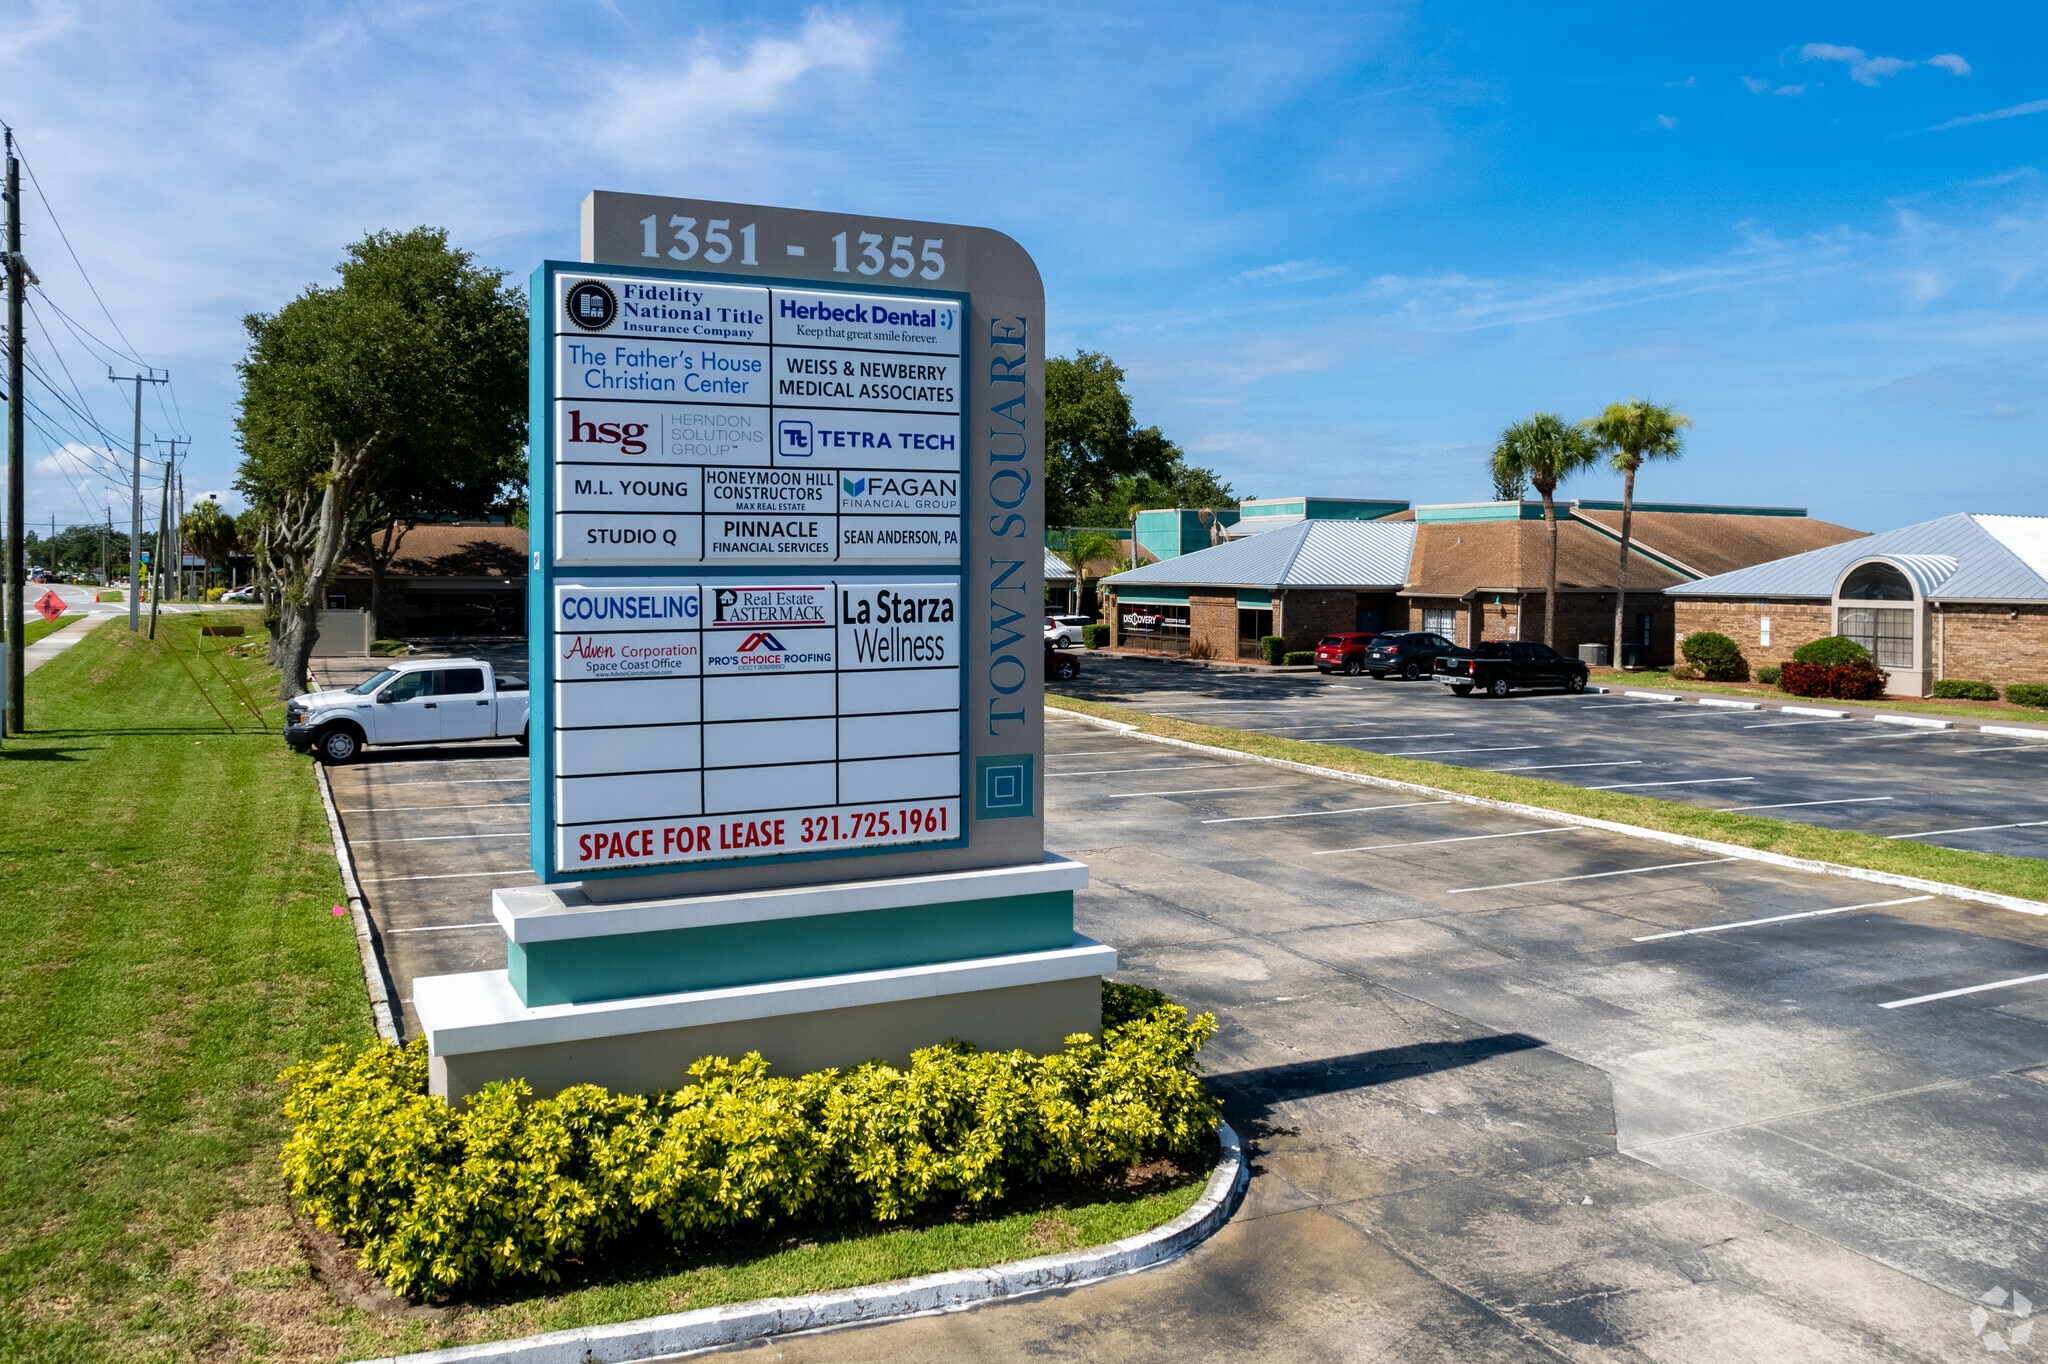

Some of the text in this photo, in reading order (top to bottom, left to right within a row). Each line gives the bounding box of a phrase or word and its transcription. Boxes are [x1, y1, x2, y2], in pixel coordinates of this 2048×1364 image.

[639, 213, 759, 266] 1351
[831, 230, 946, 281] 1355
[624, 284, 703, 306] Fidelity
[624, 302, 763, 324] National Title
[780, 300, 868, 323] Herbeck
[872, 306, 936, 327] Dental
[624, 321, 754, 339] Insurance Company
[797, 325, 938, 343] Keep that great smile forever.
[568, 345, 762, 372] The Father's House
[787, 358, 947, 381] WEISS & NEWBERRY
[585, 368, 749, 394] Christian Center
[779, 380, 953, 402] MEDICAL ASSOCIATES
[672, 414, 751, 427] HERNDON
[568, 410, 649, 455] hsg
[671, 429, 763, 442] SOLUTIONS
[818, 430, 955, 450] TETRA TECH
[575, 480, 687, 496] M.L. YOUNG
[707, 471, 833, 486] HONEYMOON HILL
[869, 478, 956, 496] FAGAN
[714, 486, 822, 500] CONSTRUCTORS
[843, 499, 956, 508] FINANCIAL GROUP
[724, 521, 818, 537] PINNACLE
[989, 317, 1031, 736] TOWN SQUARE
[587, 529, 676, 546] STUDIO Q
[844, 530, 957, 546] SEAN ANDERSON, PA
[713, 543, 828, 552] FINANCIAL SERVICES
[562, 596, 698, 619] COUNSELING
[744, 592, 814, 606] Real Estate
[843, 590, 953, 624] La Starza
[563, 636, 697, 659] Advon Corporation
[854, 627, 944, 663] Wellness
[586, 659, 682, 673] Space Coast Office
[708, 653, 831, 665] PRO'S CHOICE ROOFING
[579, 807, 947, 862] SPACE FOR LEASE 321.725.1961
